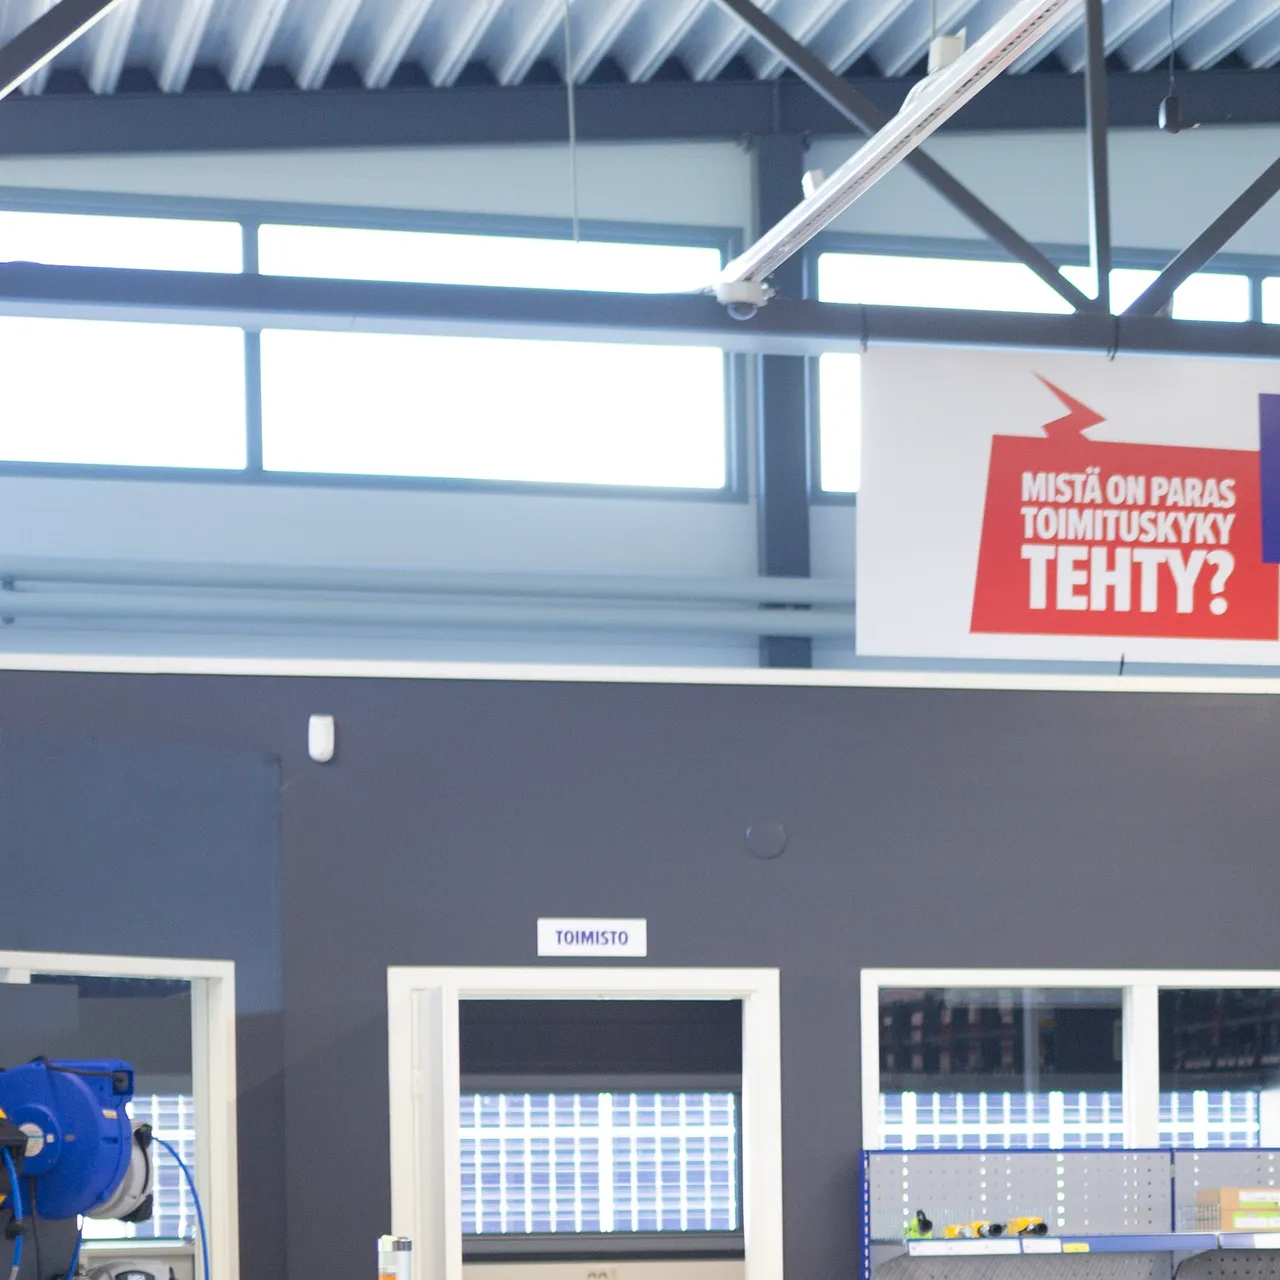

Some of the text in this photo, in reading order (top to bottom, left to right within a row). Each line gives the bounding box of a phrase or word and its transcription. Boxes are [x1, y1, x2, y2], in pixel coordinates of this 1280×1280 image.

[1021, 466, 1236, 509] MISTÄ ON PARAS
[1020, 507, 1236, 545] TOIMITUSKYKY
[1020, 544, 1235, 615] TEHTY?
[555, 930, 629, 946] TOIMISTO
